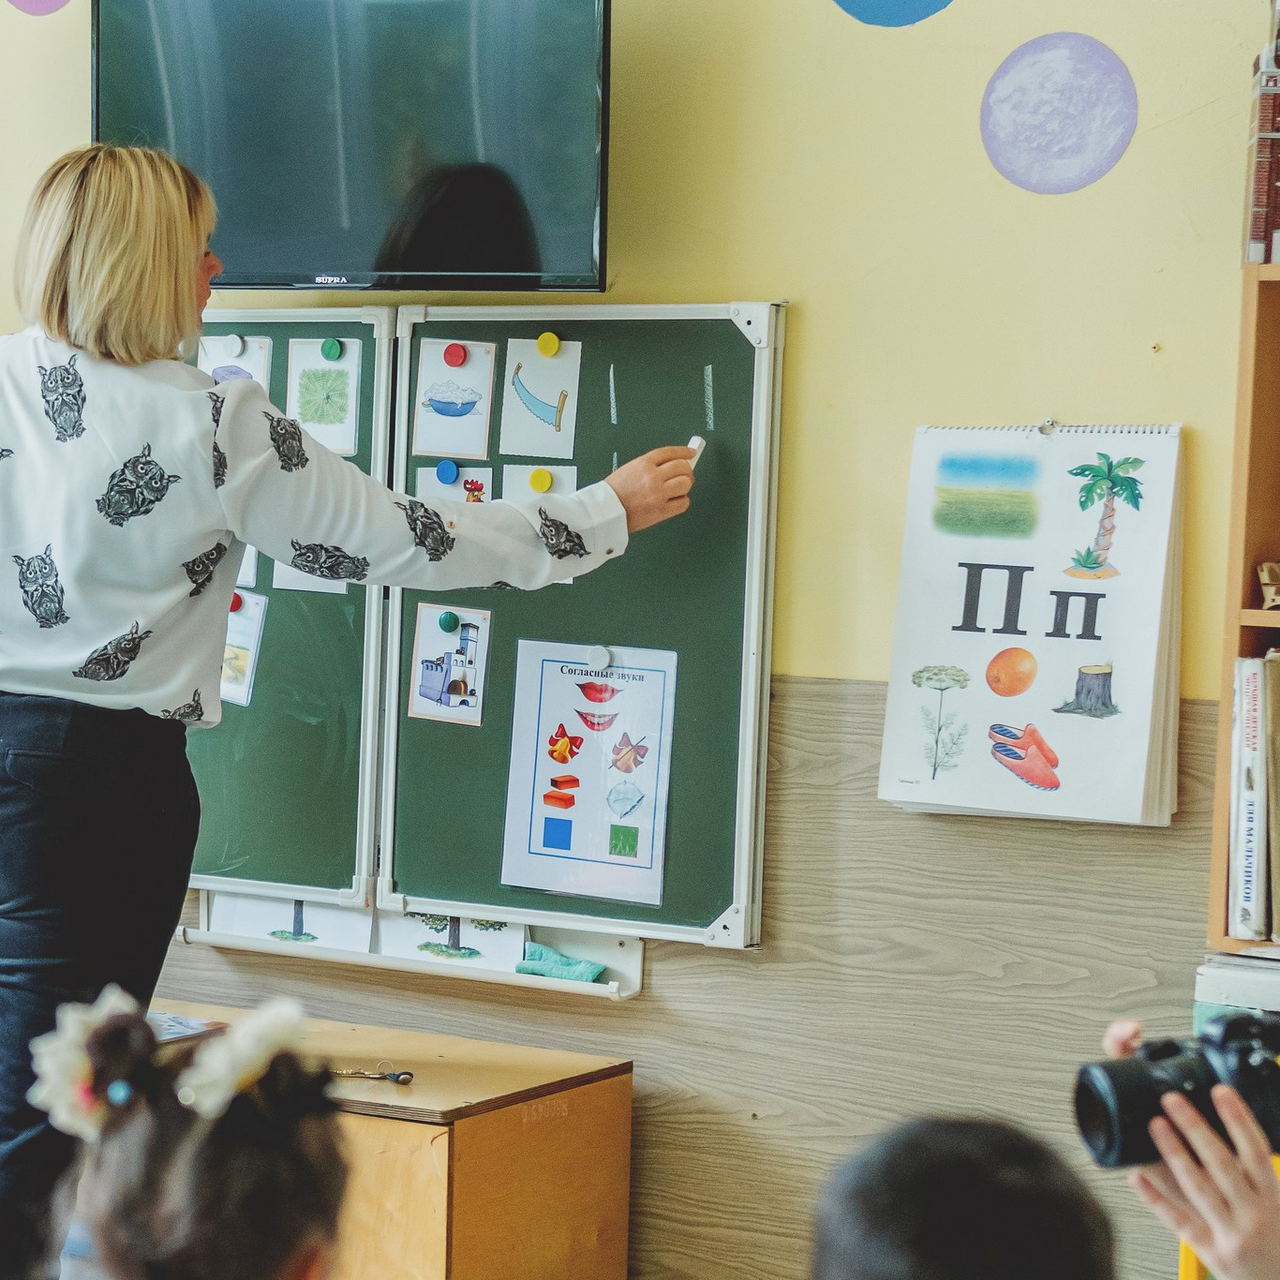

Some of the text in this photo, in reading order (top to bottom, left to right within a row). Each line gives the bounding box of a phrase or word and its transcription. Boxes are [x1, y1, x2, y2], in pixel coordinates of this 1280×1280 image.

[315, 276, 348, 284] SUPRA
[951, 562, 1107, 641] П п
[560, 665, 645, 683] Согласные звуки
[1243, 800, 1255, 903] ДЛЯ МАЛЬЧИКОВ
